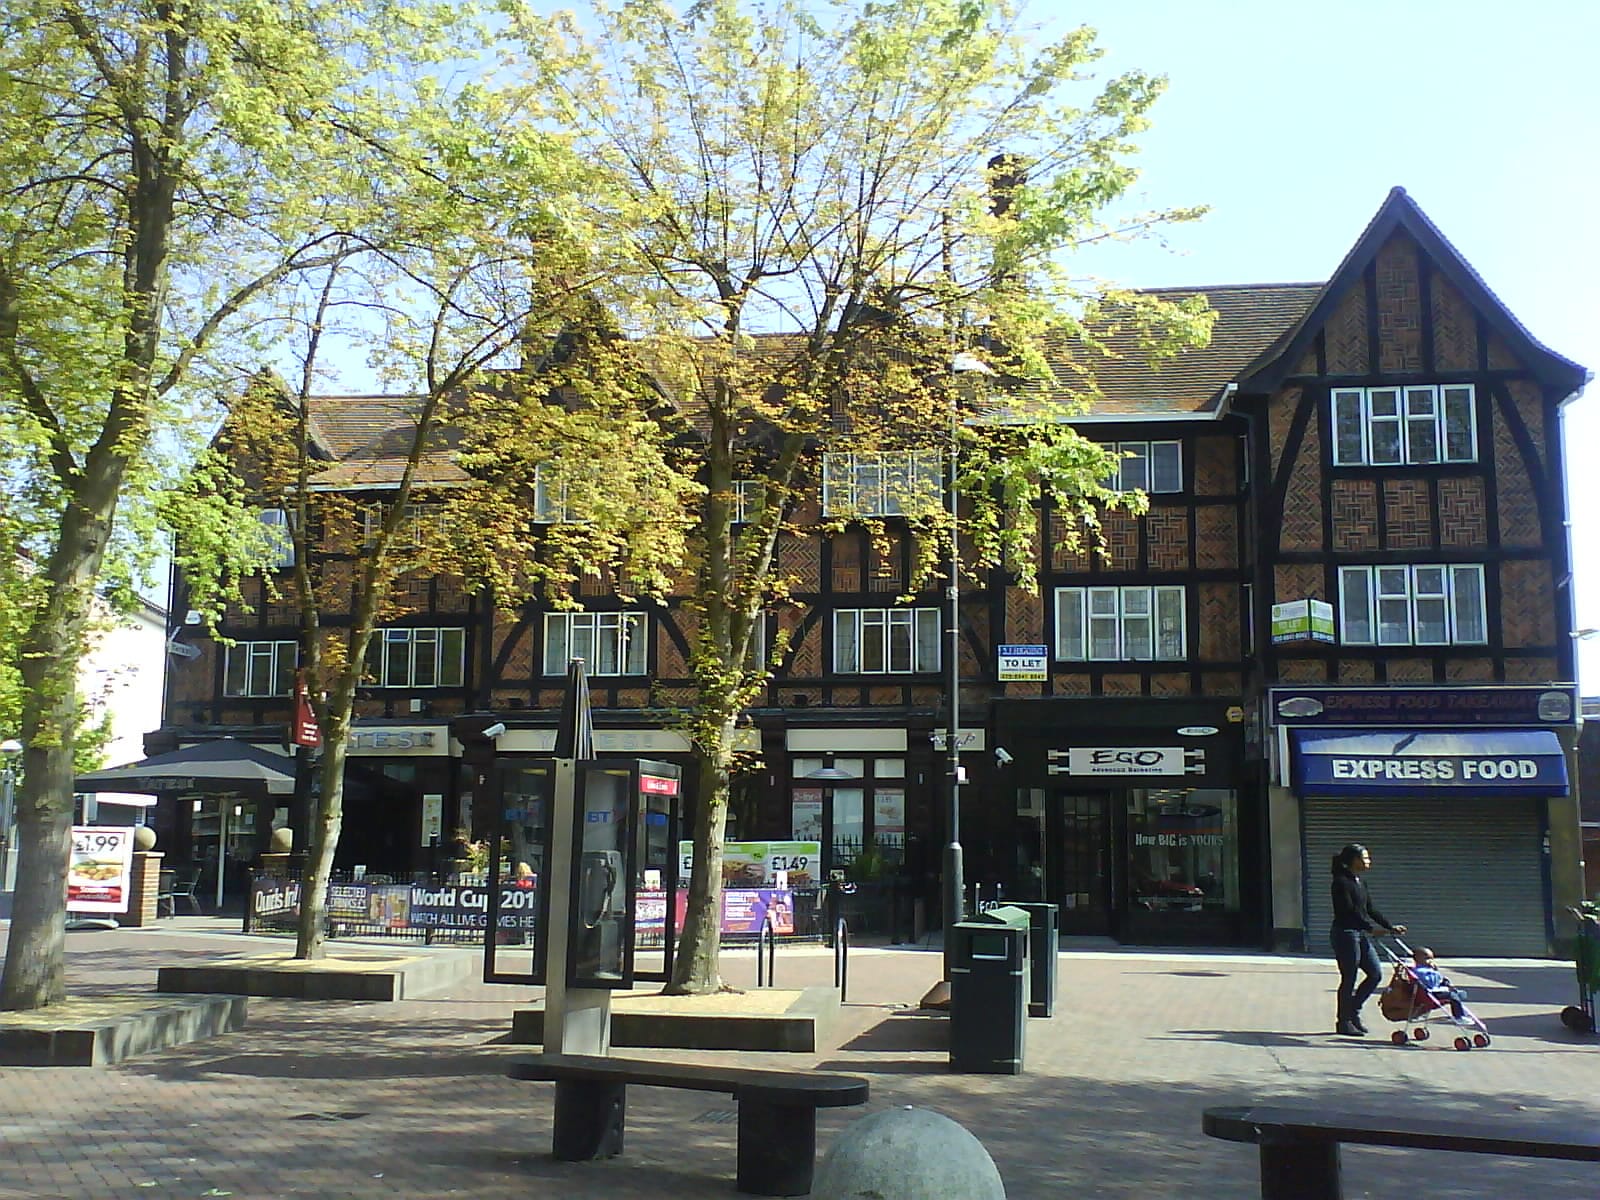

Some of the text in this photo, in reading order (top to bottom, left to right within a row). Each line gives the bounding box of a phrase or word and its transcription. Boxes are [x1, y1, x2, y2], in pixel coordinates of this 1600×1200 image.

[1004, 659, 1041, 667] TO LET
[1089, 750, 1164, 766] EGO
[1332, 759, 1538, 779] EXPRESS FOOD
[588, 811, 610, 823] BT
[75, 835, 119, 851] £1.99
[1135, 833, 1156, 845] How
[1158, 833, 1176, 846] BIG
[1178, 834, 1188, 846] is
[772, 856, 808, 871] £1.49
[412, 887, 457, 907] World
[500, 890, 535, 909] 201
[479, 914, 517, 928] GMES
